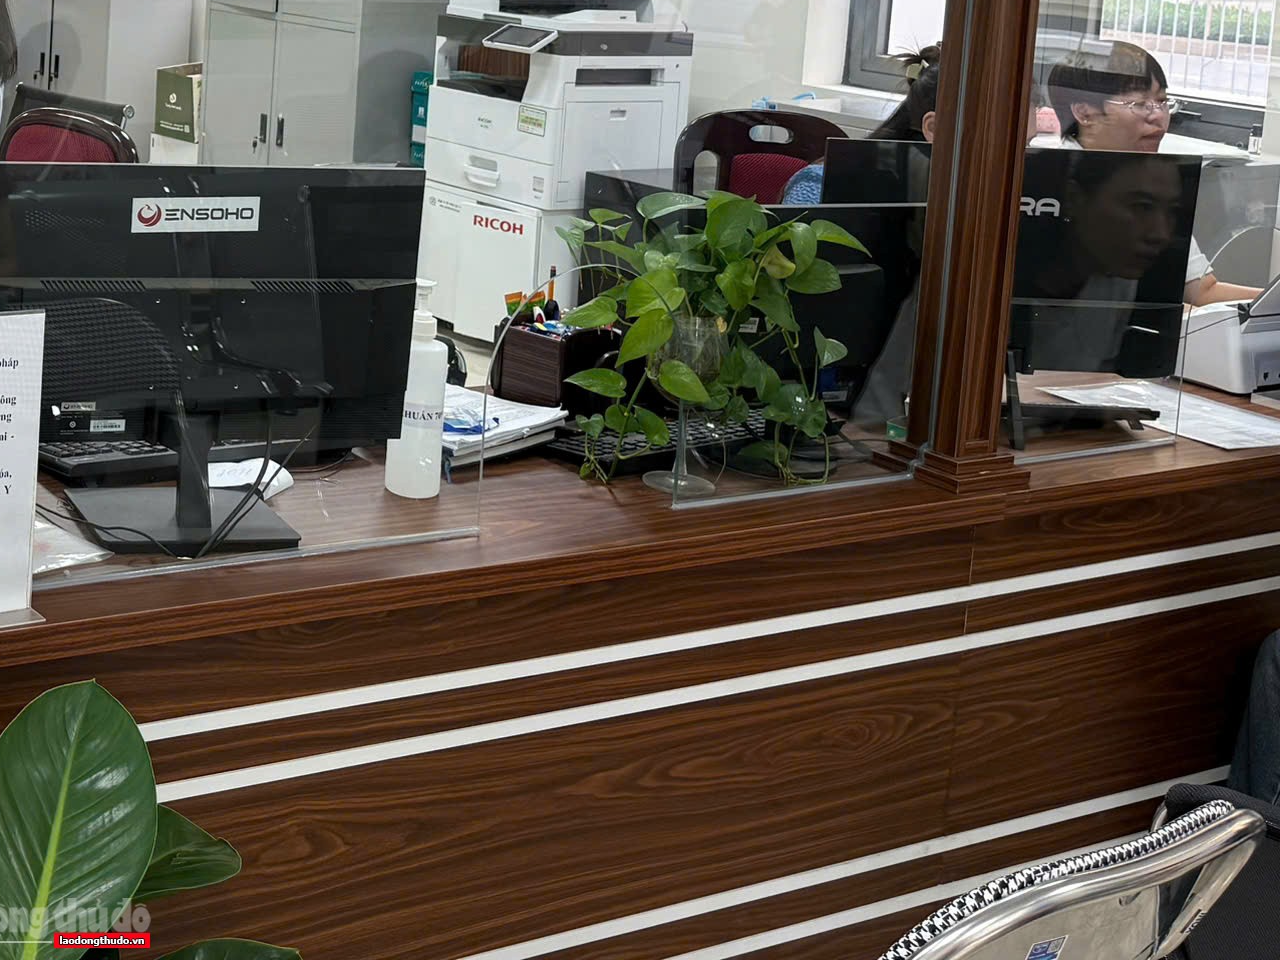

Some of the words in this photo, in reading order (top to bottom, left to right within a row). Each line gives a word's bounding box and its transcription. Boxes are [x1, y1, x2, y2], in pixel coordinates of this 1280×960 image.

[164, 207, 254, 221] ENSOHO
[473, 214, 524, 235] RICOH
[3, 484, 12, 494] Y
